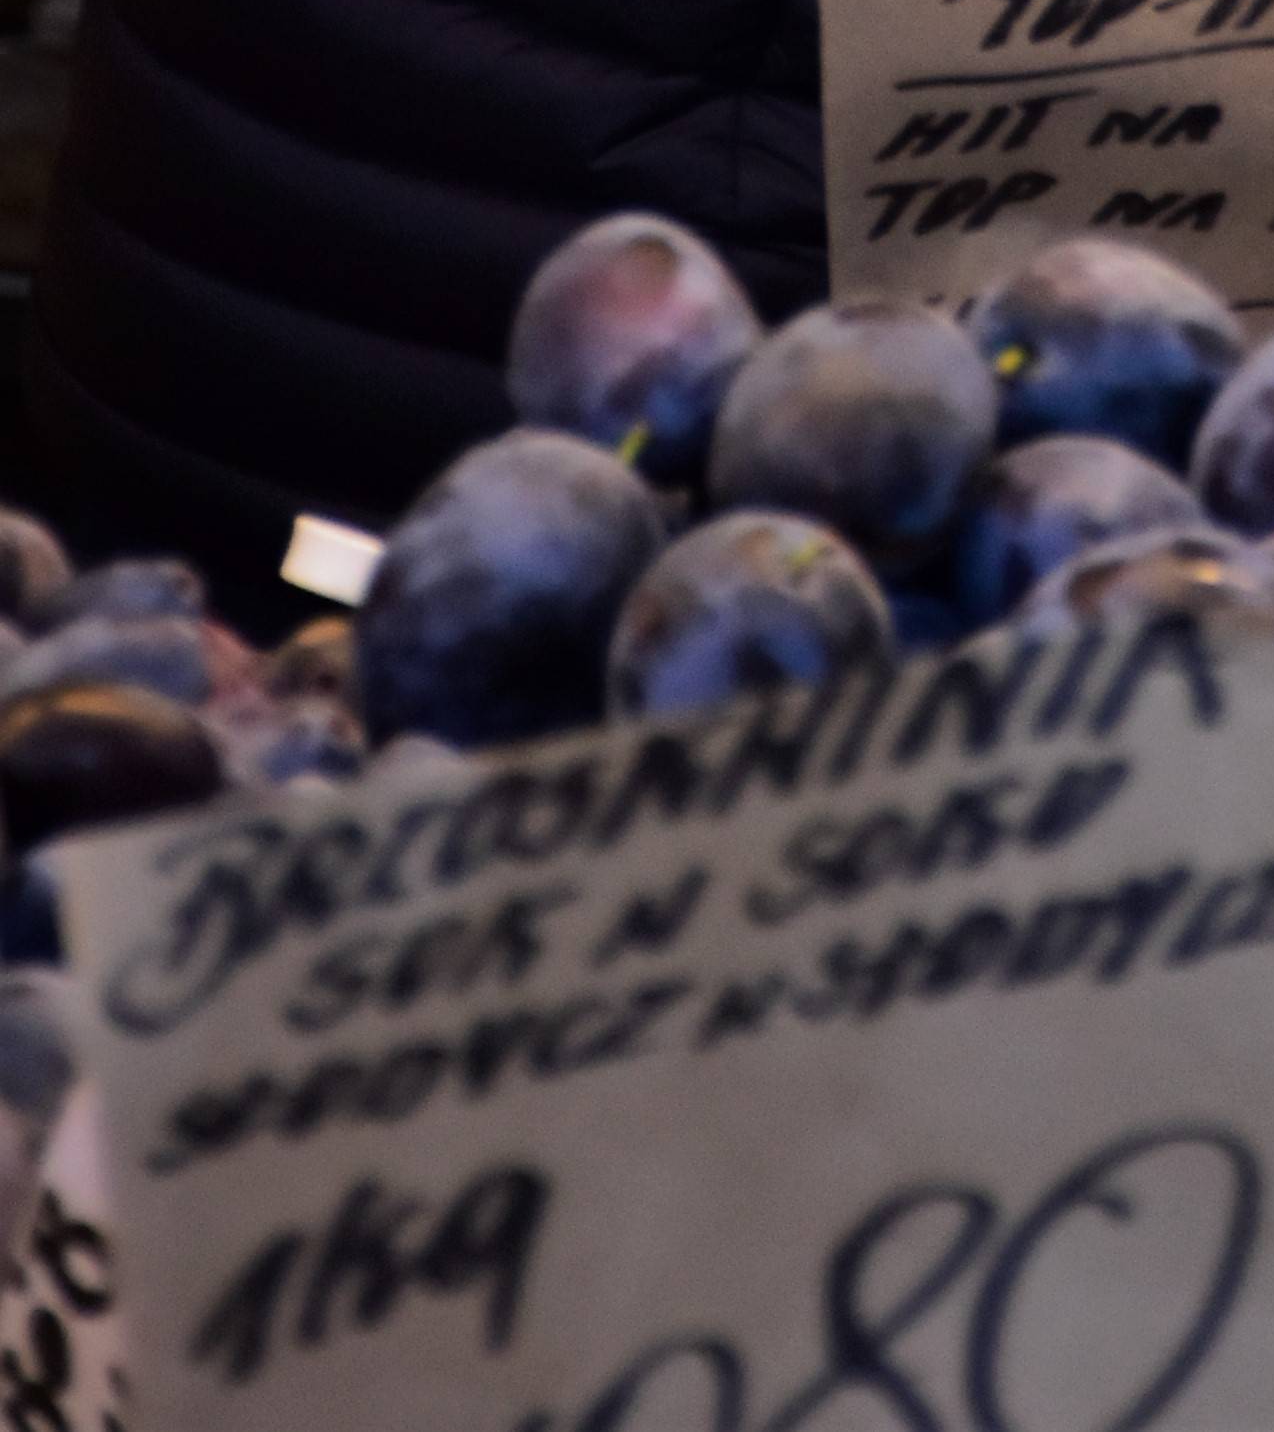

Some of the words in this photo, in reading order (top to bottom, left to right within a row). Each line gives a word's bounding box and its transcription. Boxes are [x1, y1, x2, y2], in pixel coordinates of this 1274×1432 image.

[873, 88, 1100, 164] HIT
[1085, 104, 1225, 148] NA
[865, 171, 1060, 244] TOP
[1089, 188, 1226, 231] NA
